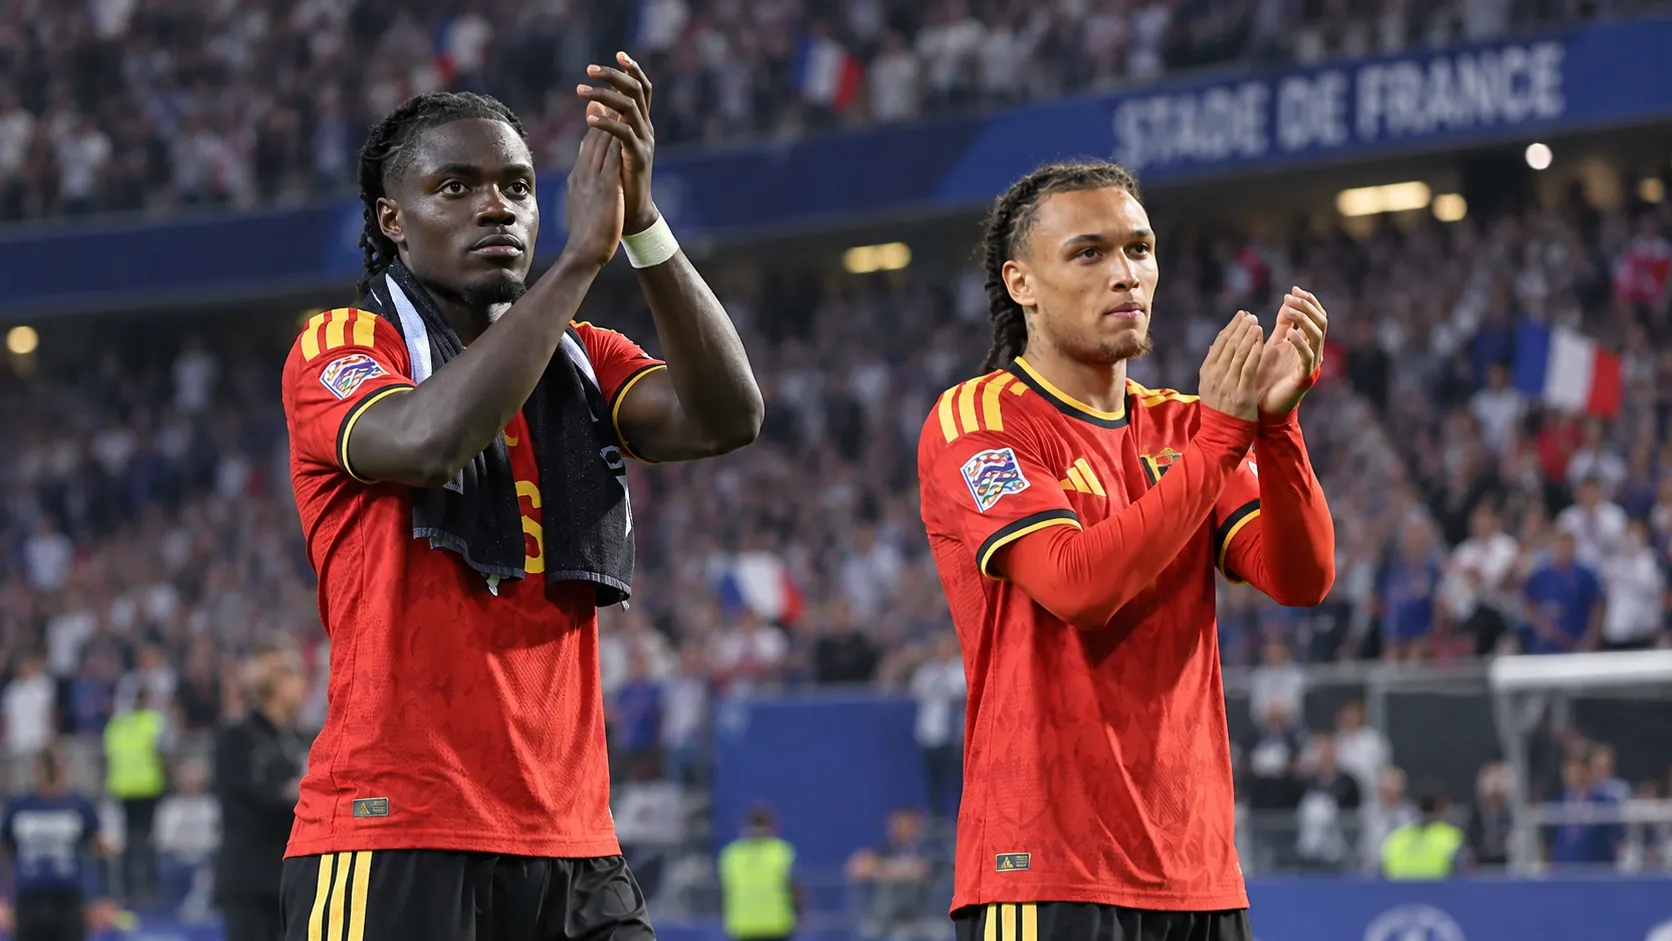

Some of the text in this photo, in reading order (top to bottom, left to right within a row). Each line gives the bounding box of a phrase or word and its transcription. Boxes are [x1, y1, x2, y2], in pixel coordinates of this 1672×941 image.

[1114, 42, 1565, 166] STADE DE FRANCE
